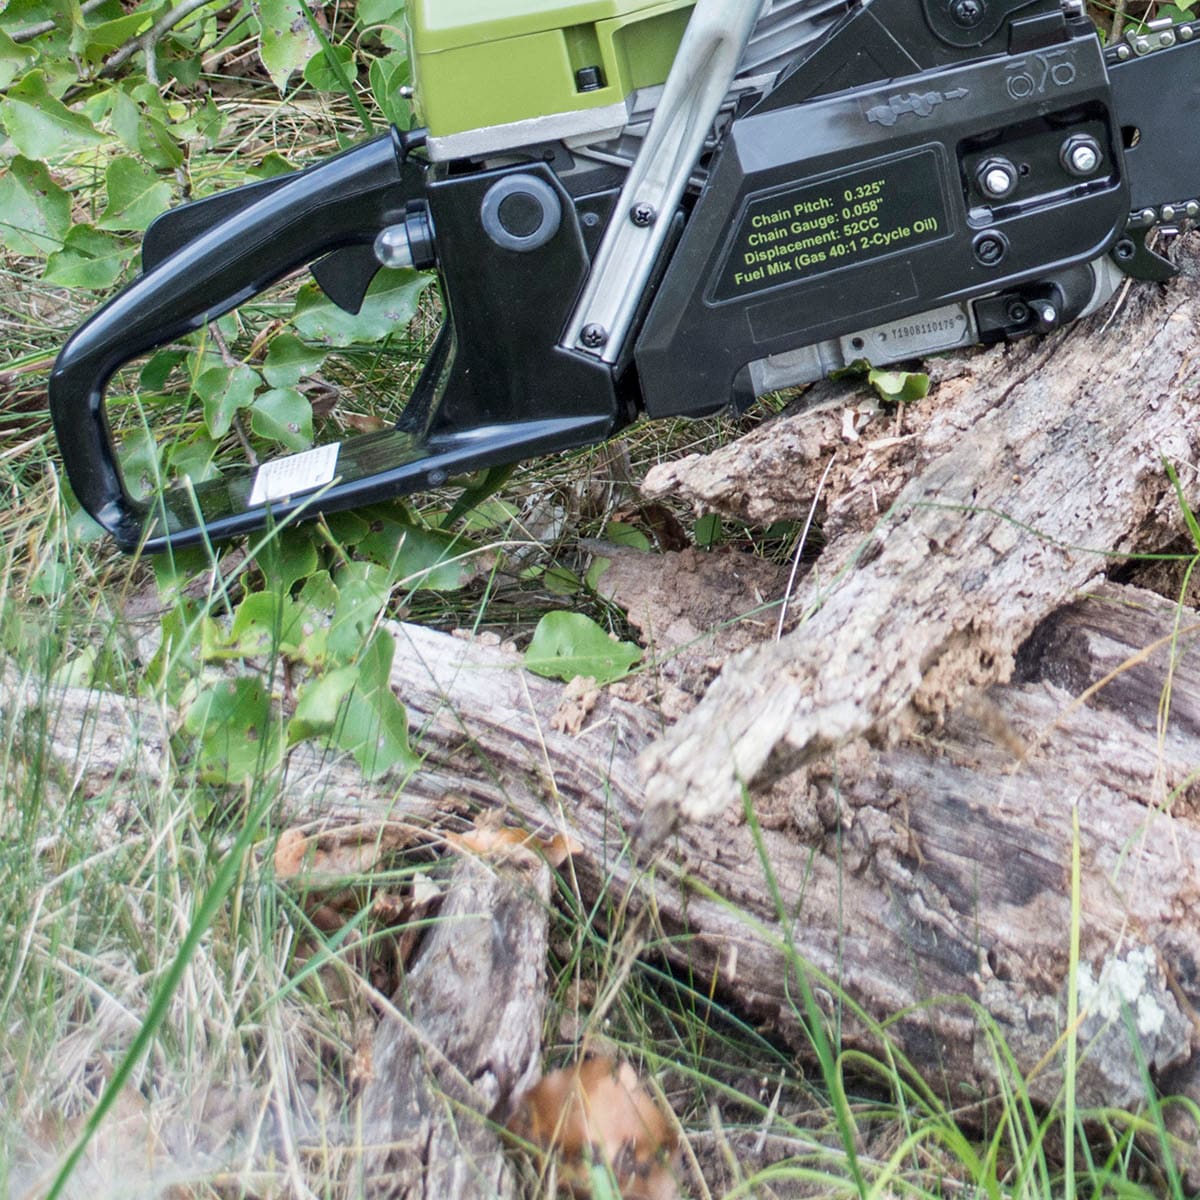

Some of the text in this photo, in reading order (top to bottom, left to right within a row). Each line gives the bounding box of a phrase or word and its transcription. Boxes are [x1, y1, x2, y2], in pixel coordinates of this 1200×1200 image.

[748, 198, 884, 247] Chain Gauge: 0.058"
[752, 180, 886, 228] Chain Pitch: 0.325"
[734, 216, 938, 285] Fuel Mix (Gas 40:1 2-Cycle Oil)
[744, 216, 880, 265] Displacement: 52CC
